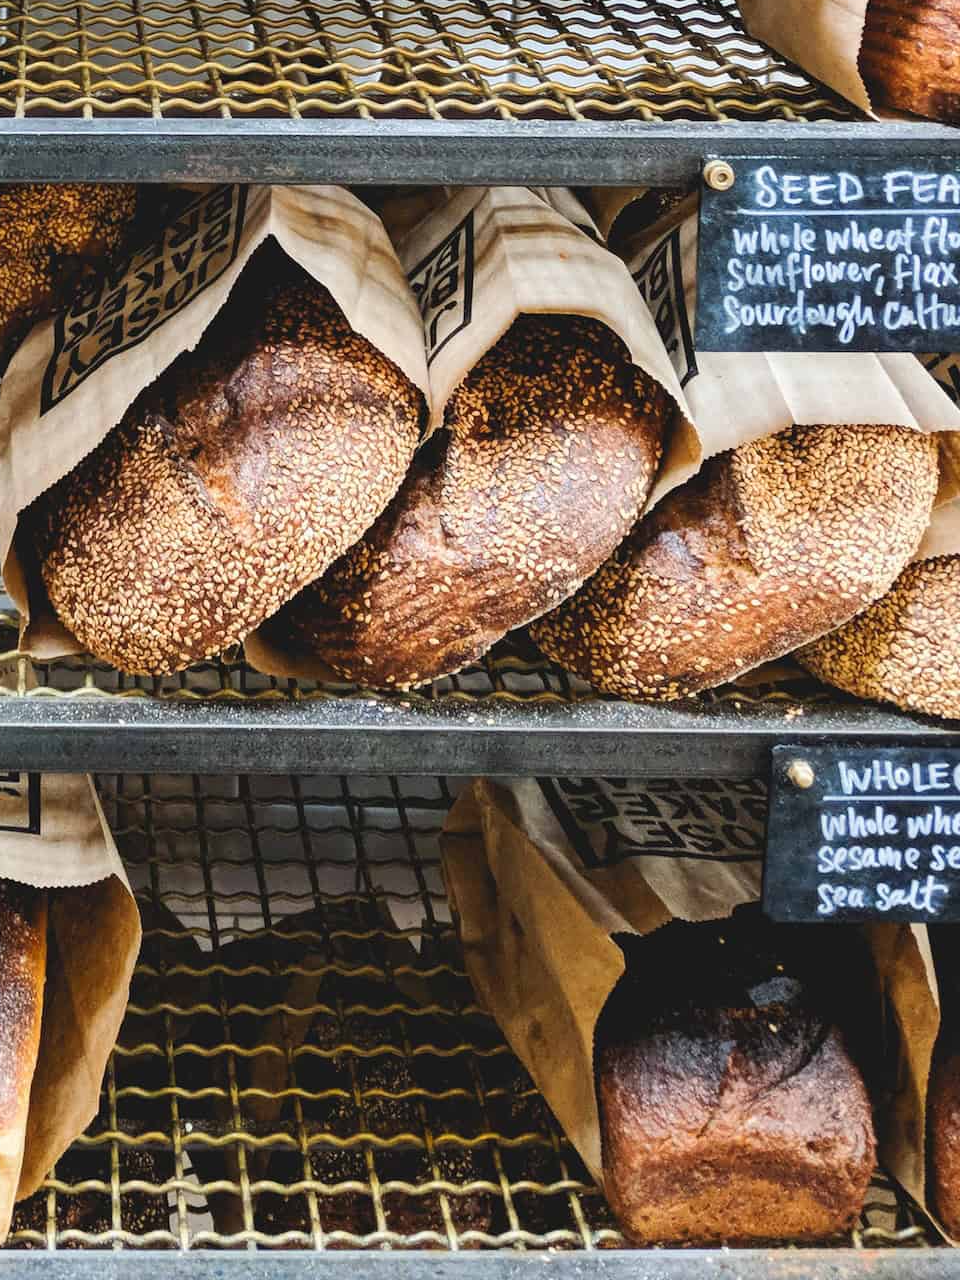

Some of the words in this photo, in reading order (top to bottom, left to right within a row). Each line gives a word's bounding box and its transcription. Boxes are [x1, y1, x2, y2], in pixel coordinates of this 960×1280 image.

[753, 165, 865, 208] SEED
[732, 221, 817, 255] whole
[825, 216, 918, 255] wheat
[62, 219, 232, 353] BAKER
[894, 252, 960, 292] flax
[59, 244, 229, 392] JOSEY
[874, 874, 950, 914] salt
